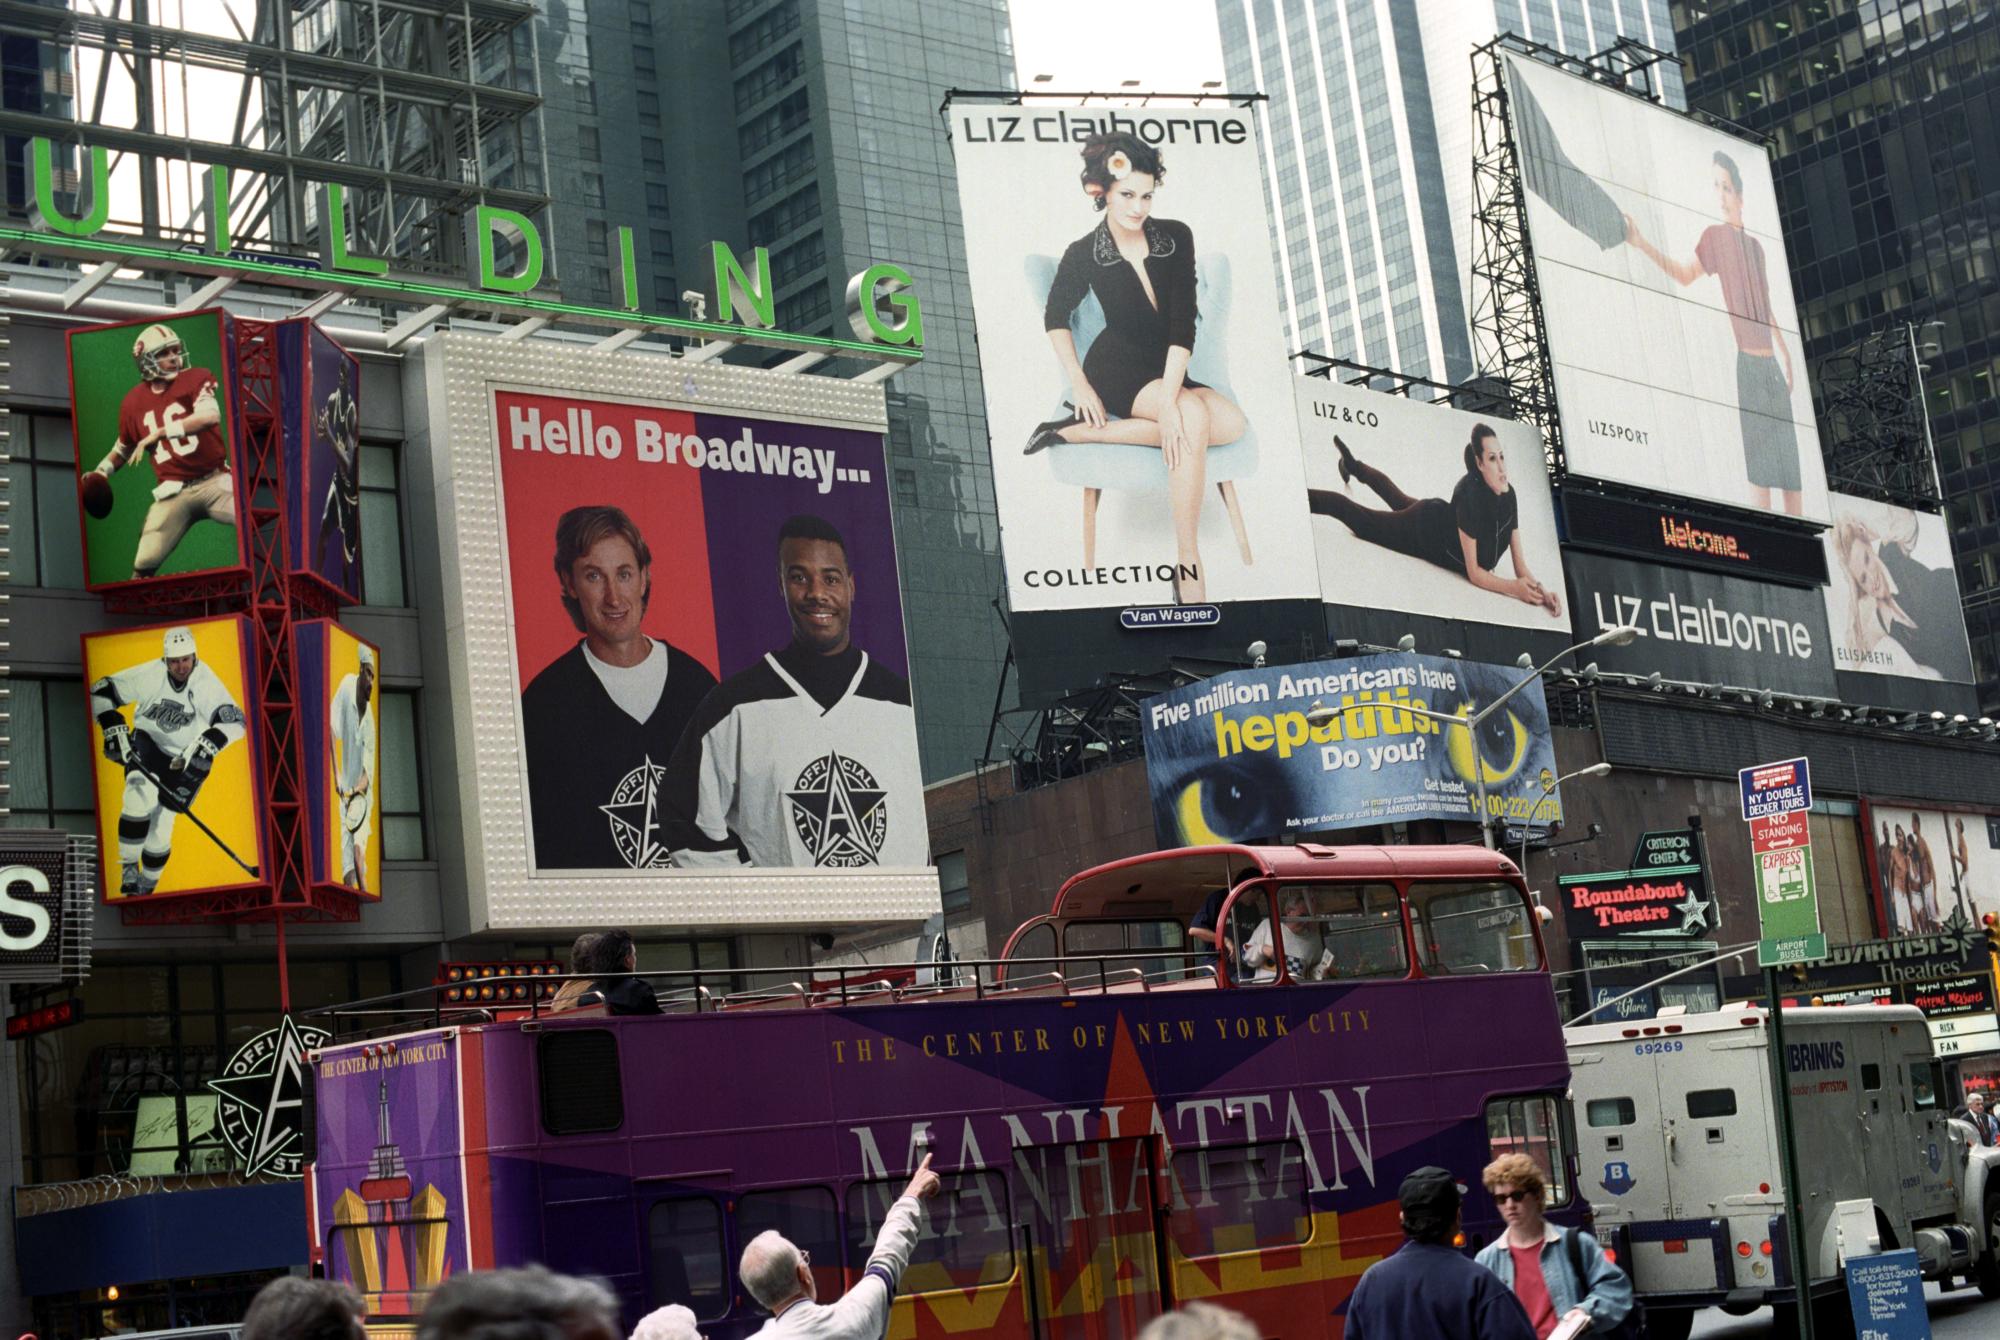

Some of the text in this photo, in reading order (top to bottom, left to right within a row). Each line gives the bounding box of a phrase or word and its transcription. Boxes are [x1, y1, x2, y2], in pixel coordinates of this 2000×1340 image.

[964, 110, 1247, 144] LIZ claiborne
[1313, 401, 1379, 428] LIZ & CO
[143, 402, 199, 464] 16
[1588, 419, 1649, 446] LIZSPORT
[509, 406, 871, 494] Hello Broadway...
[1023, 563, 1198, 588] COLLECTION
[1131, 608, 1212, 624] Van Wagner
[1594, 592, 1813, 659] LIZ claiborne
[1837, 647, 1893, 665] ELISABETH
[1151, 664, 1457, 731] Five million Americans have
[1213, 687, 1440, 759] hepatitis.
[1321, 736, 1426, 771] Do you?
[1748, 785, 1804, 805] NY DOUBLE
[1749, 801, 1779, 816] DECKER
[1780, 796, 1805, 810] TOURS
[794, 808, 813, 849] ALL
[1768, 814, 1788, 826] NO
[614, 822, 635, 859] ALL
[1758, 823, 1803, 840] STANDING
[1646, 836, 1690, 850] CRITERION
[1648, 851, 1679, 864] CENTER
[1763, 849, 1801, 869] EXPRESS
[1571, 881, 1686, 908] Roundabout
[1594, 905, 1669, 927] Theatre
[1775, 940, 1808, 951] AIRPORT
[1780, 949, 1806, 960] BUSES
[1877, 960, 1961, 984] Theatres
[831, 1008, 1373, 1063] THE CENTER OF NEW YORK CITY
[1939, 1022, 1955, 1034] RISK
[1635, 1040, 1683, 1056] 69269
[1940, 1041, 1959, 1053] FAN
[320, 1042, 447, 1079] THE CENTER OF NEW YORK CITY
[223, 1102, 249, 1150] ALL
[273, 1157, 301, 1172] ST
[850, 1085, 1378, 1248] MANHATTAN
[1852, 1267, 1867, 1276] Call
[1867, 1287, 1899, 1298] delivery
[1879, 1280, 1902, 1288] home
[1870, 1302, 1907, 1313] New York
[1871, 1311, 1896, 1320] Times
